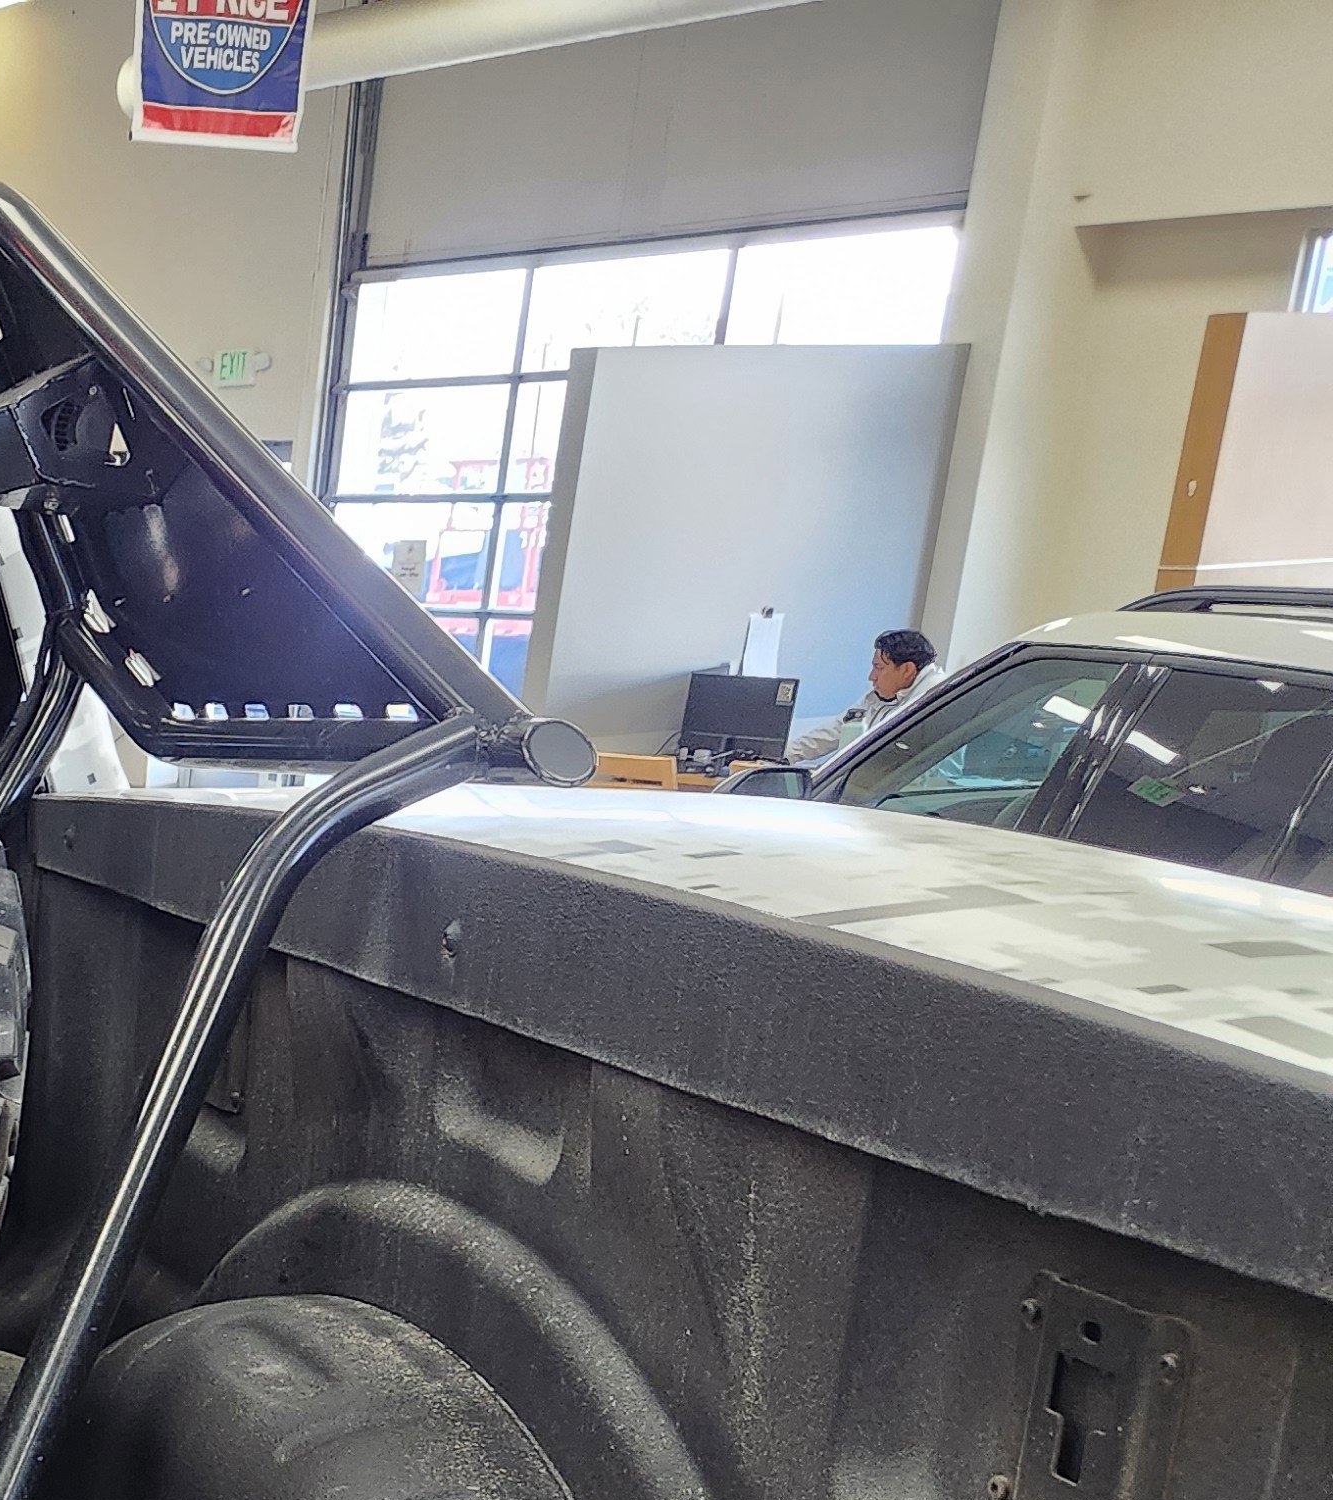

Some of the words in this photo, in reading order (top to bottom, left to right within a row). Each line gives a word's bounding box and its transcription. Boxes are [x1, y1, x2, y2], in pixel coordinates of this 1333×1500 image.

[170, 21, 271, 51] PRE-OWNED
[180, 46, 260, 74] VEHICLES
[219, 351, 248, 381] EXIT
